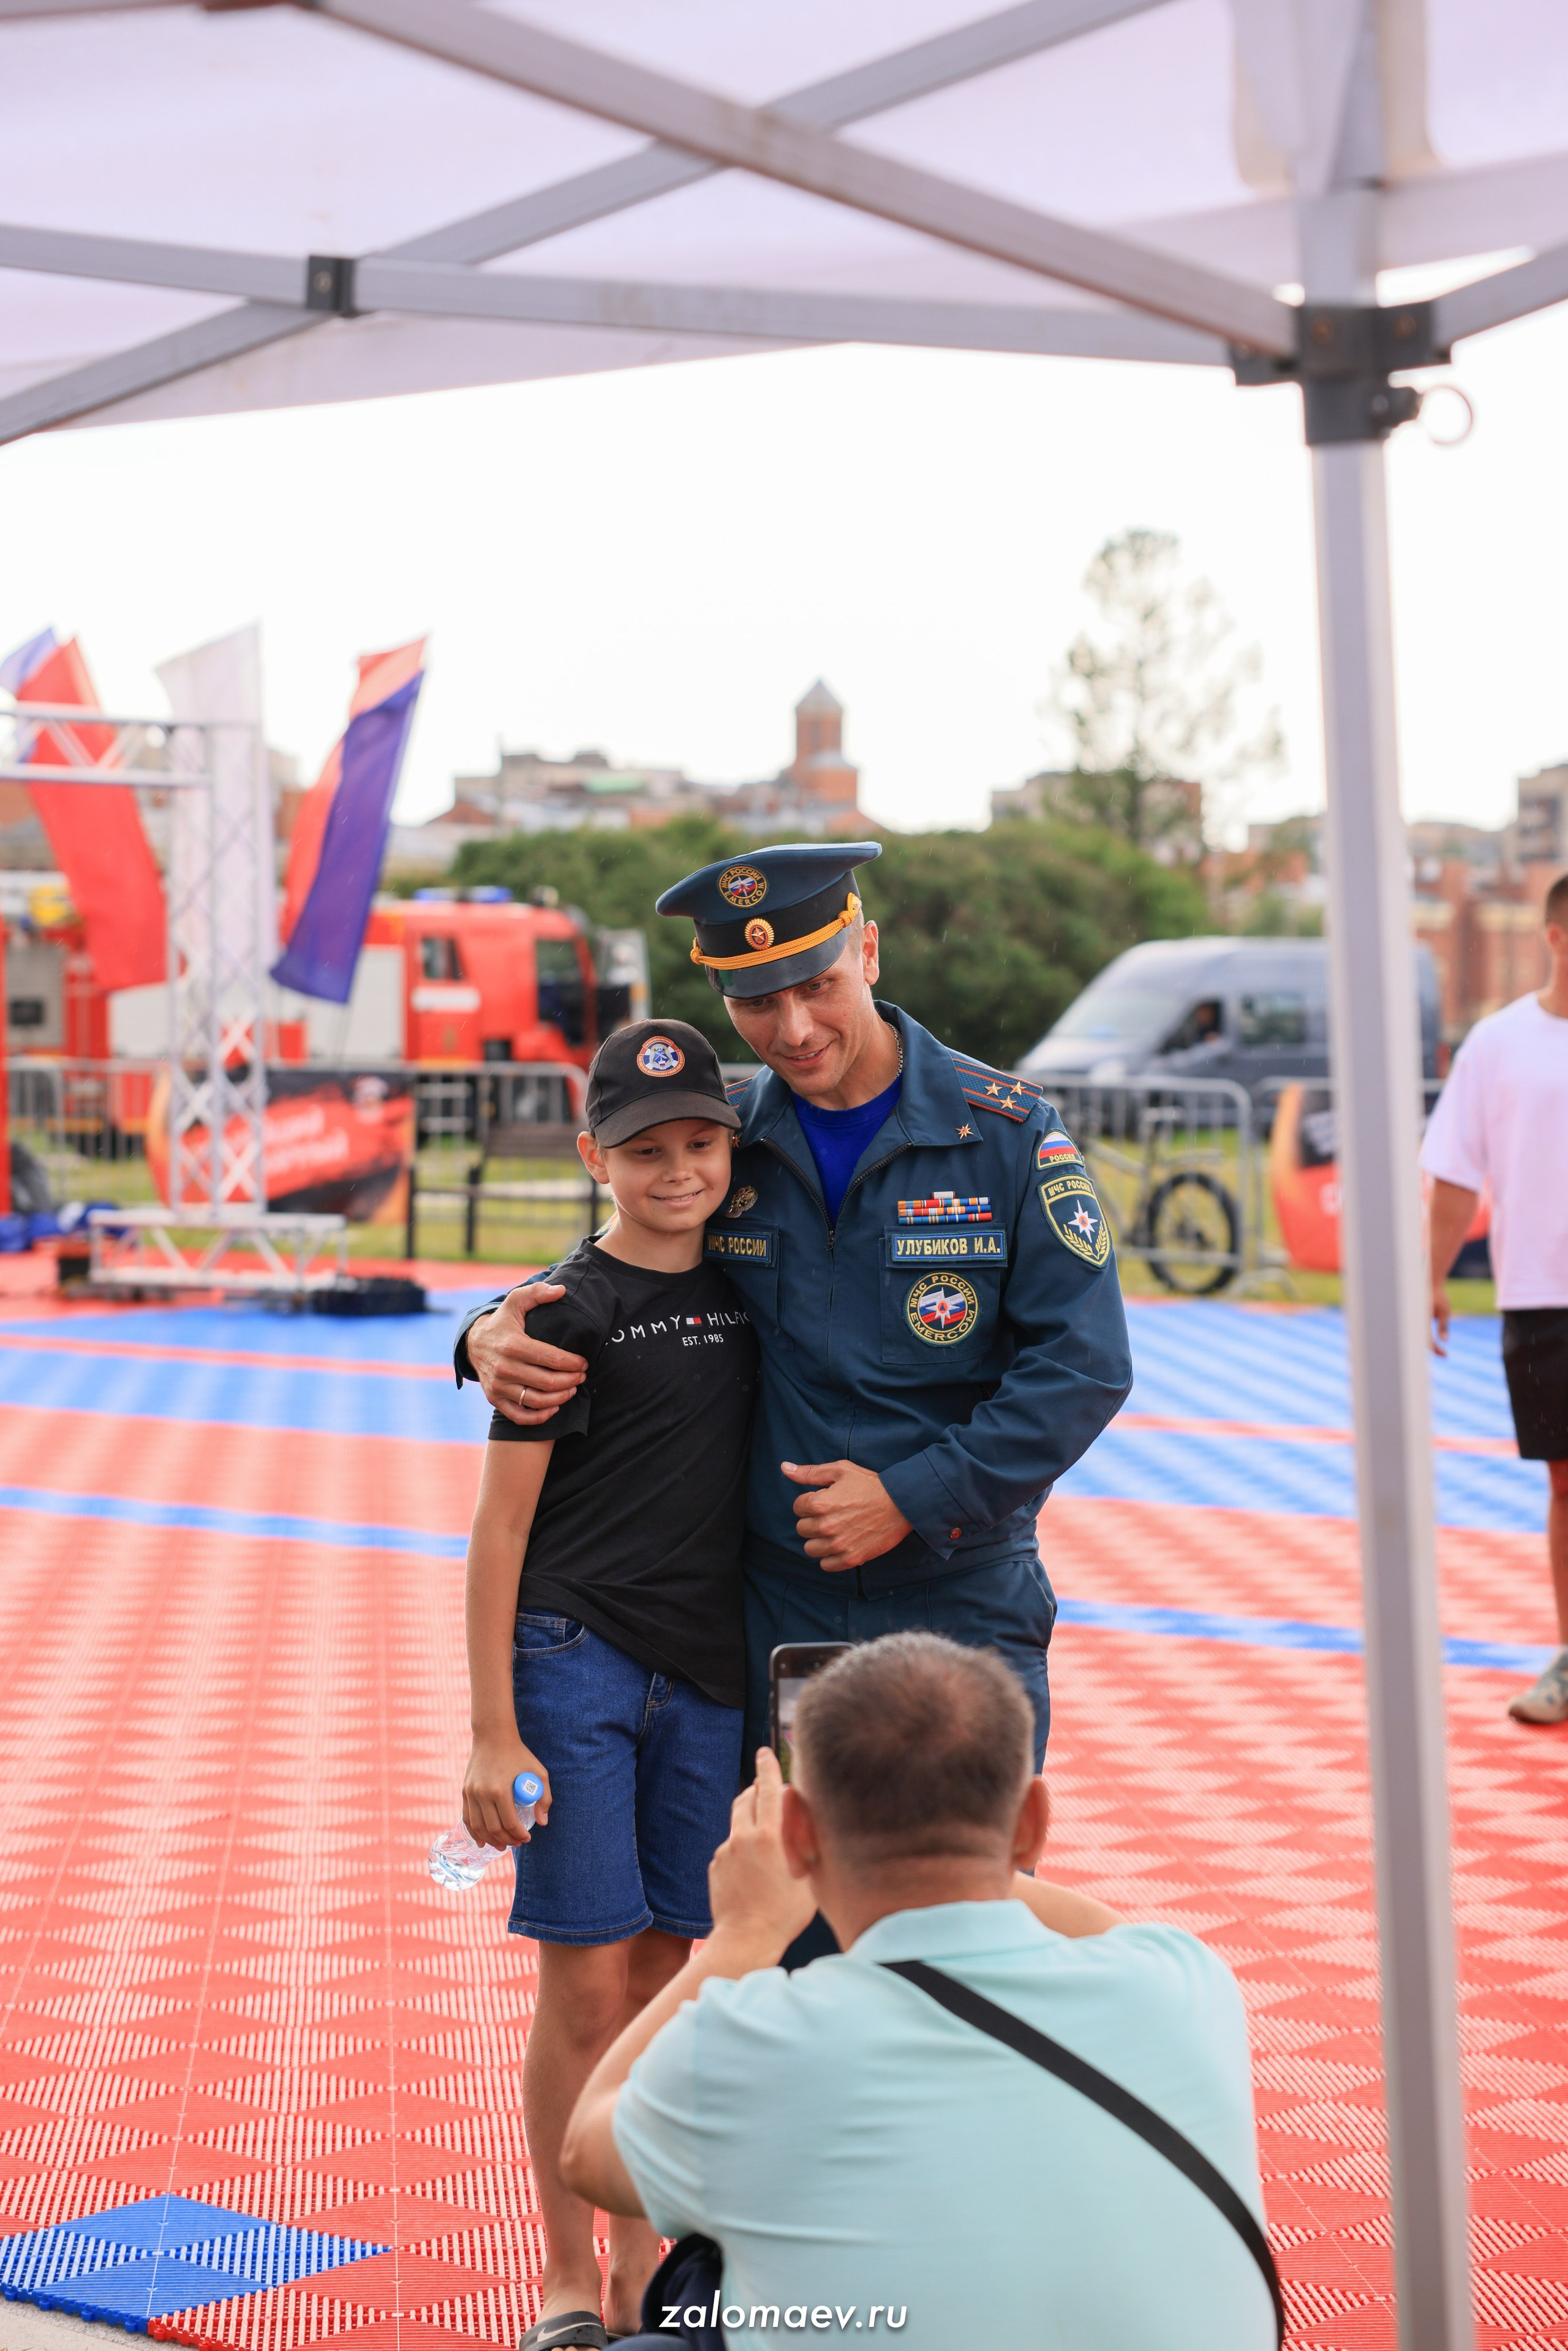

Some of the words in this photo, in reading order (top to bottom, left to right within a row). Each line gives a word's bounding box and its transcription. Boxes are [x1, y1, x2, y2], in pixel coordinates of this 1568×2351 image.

[722, 874, 731, 888] МЧС
[731, 868, 761, 881] РОССИИ
[724, 882, 764, 905] EMERCOM
[1049, 1153, 1076, 1163] РОССИЯ
[1048, 1183, 1065, 1196] МЧС
[1066, 1180, 1091, 1193] РОССИИ
[708, 1235, 725, 1253] МЧС
[728, 1237, 766, 1256] РОССИИ
[897, 1237, 968, 1256] УЛУБИКОВ
[974, 1236, 1001, 1254] И.А.
[910, 1283, 927, 1308] МЧС
[932, 1275, 975, 1305] РОССИИ
[605, 1315, 680, 1346] OMMY
[910, 1310, 975, 1341] EMERCOM
[682, 1336, 701, 1346] EST.
[704, 1334, 724, 1344] 1985
